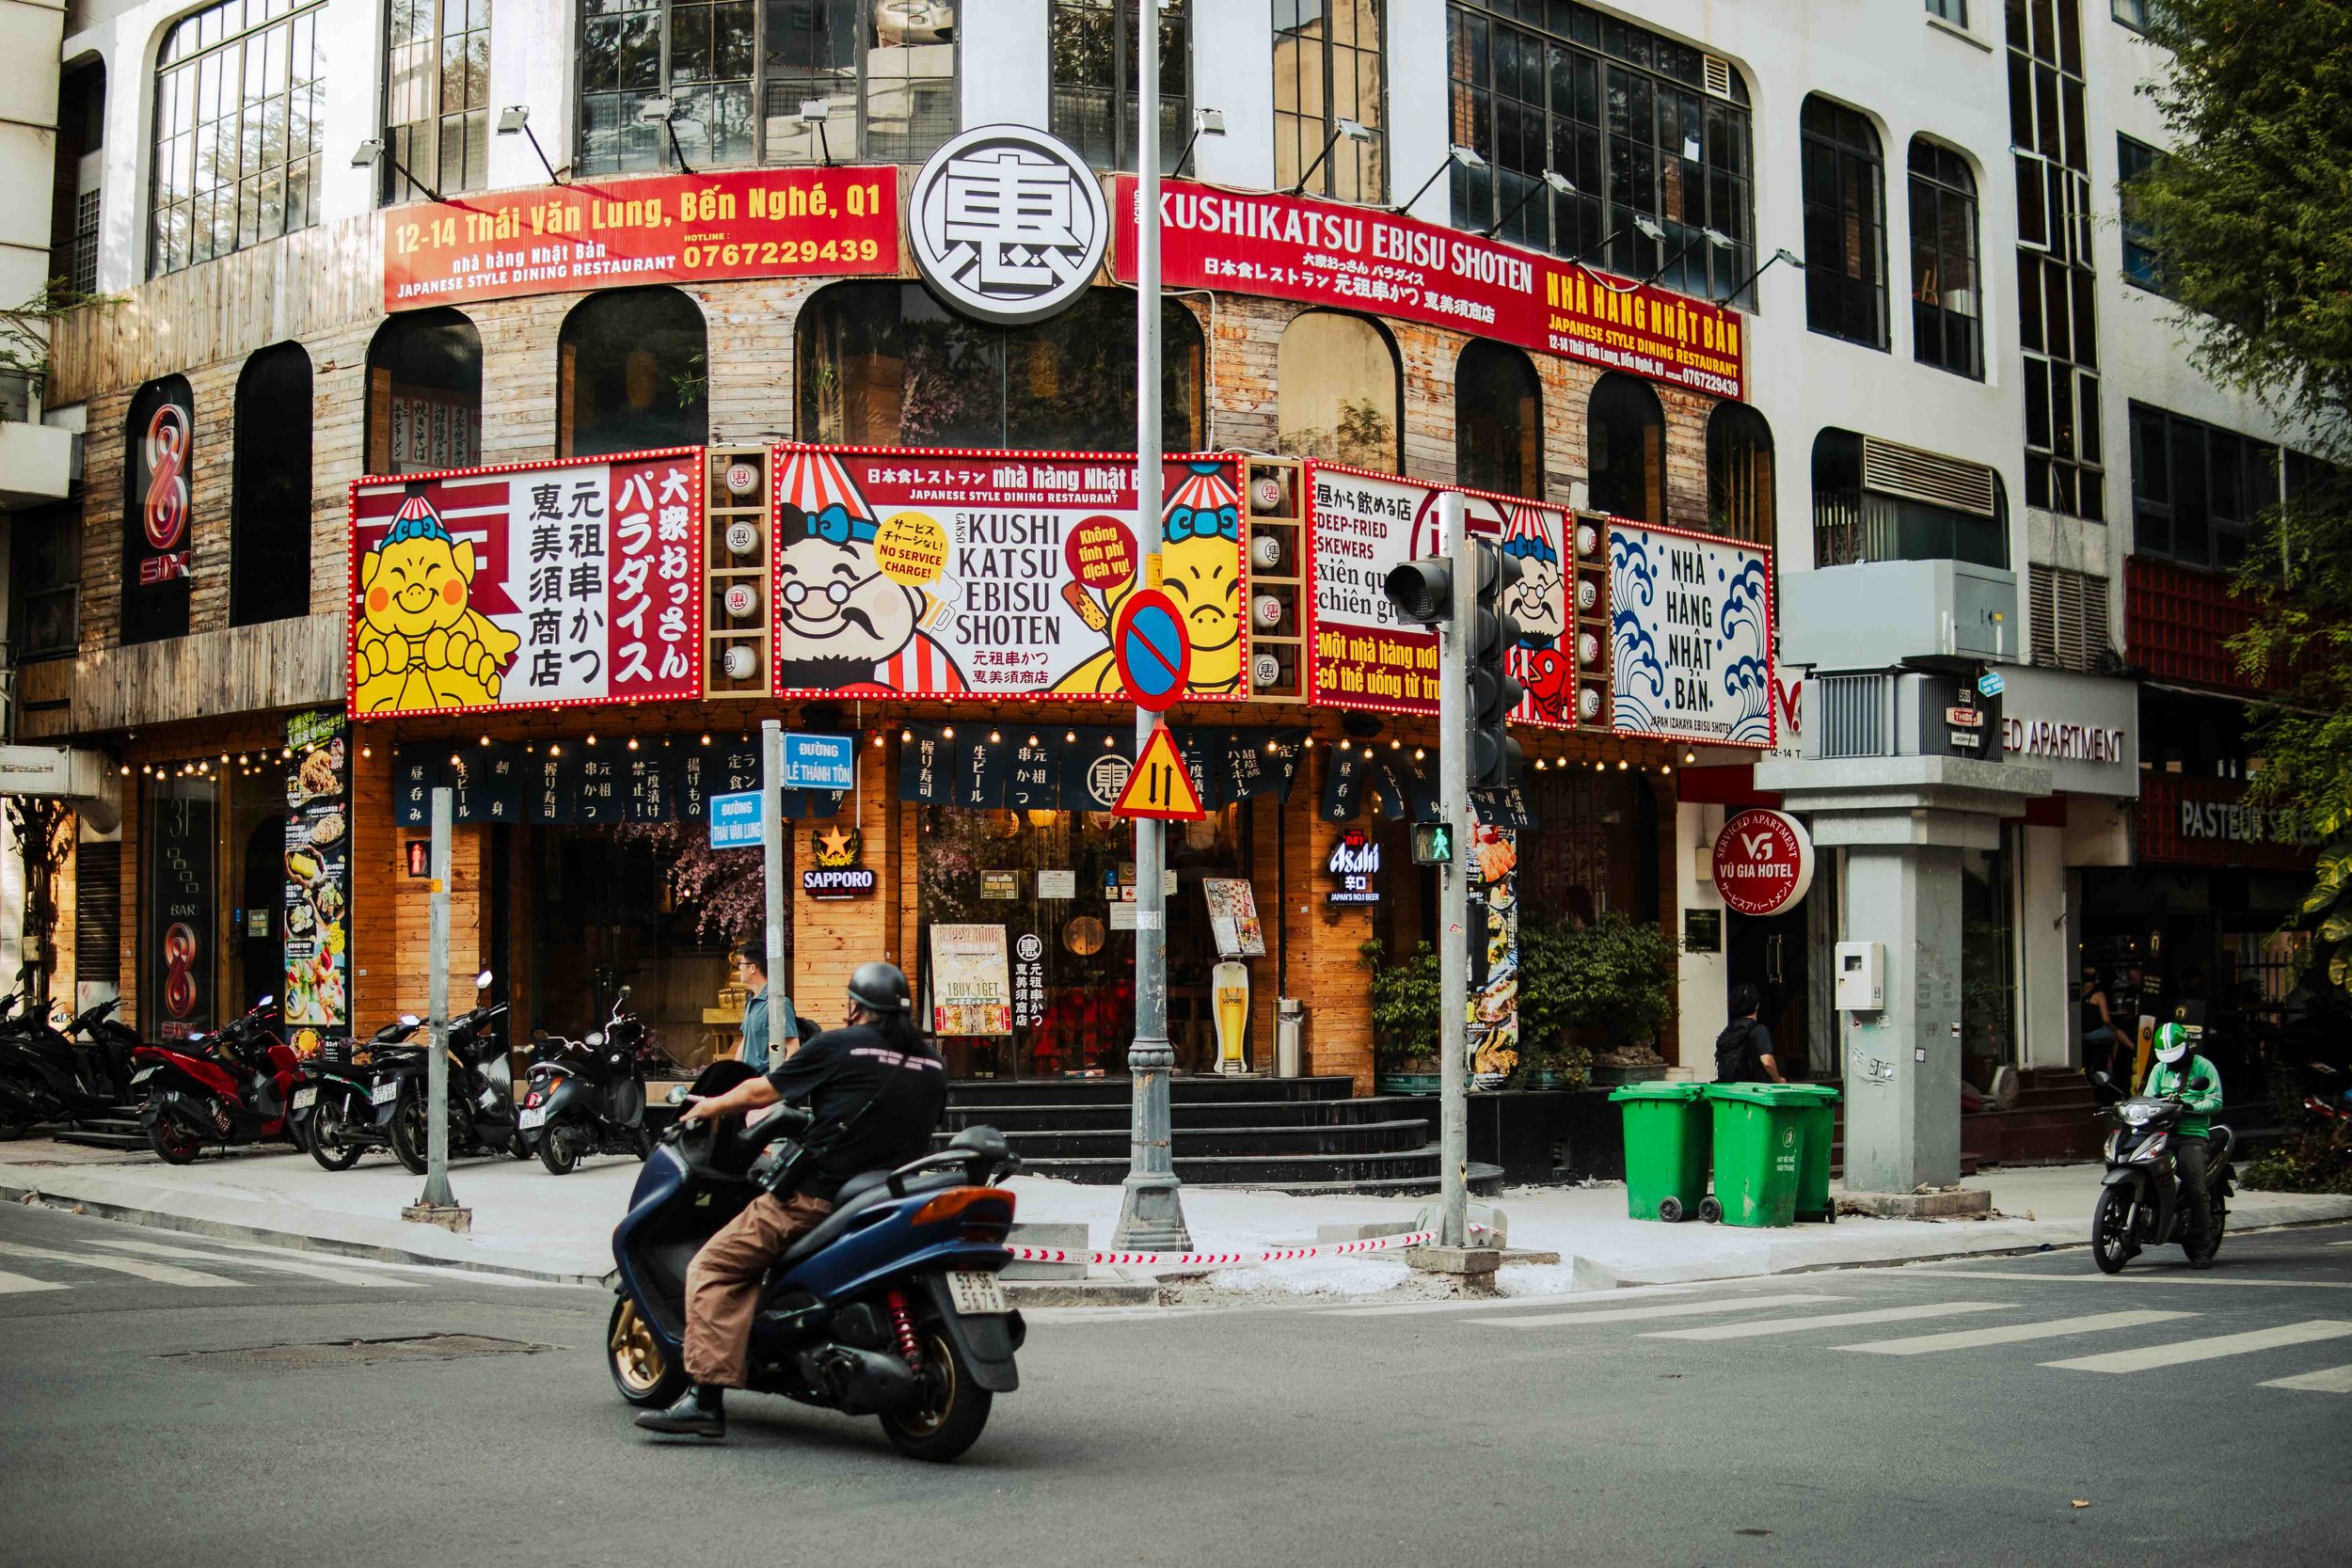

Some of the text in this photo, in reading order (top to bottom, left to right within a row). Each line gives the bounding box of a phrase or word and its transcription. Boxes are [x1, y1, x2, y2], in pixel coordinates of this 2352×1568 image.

[395, 182, 880, 254] 12-14 Thái Văn Lung, Bến Nghé, Q1
[453, 239, 606, 275] nhà hàng Nhật Bản
[683, 239, 879, 269] 0767229439
[1159, 192, 1363, 253] KUSHIKATSU
[1372, 222, 1445, 271] EBISU
[1451, 242, 1534, 294] SHOTEN
[397, 254, 676, 299] JAPANESE STYLE DINING RESTAURANT
[1204, 257, 1328, 289] 日本食レストラン
[1333, 273, 1420, 306] 元祖串かつ
[1372, 264, 1424, 287] パラダイス
[1546, 271, 1738, 357] NHÀ HÀNG NHẬT BẢN
[1548, 313, 1738, 378] JAPANESE STYLE DINING RESTAURANT
[1548, 334, 1568, 352] 12-14
[1568, 337, 1585, 356] Thái
[1655, 361, 1664, 377] Q1
[1682, 367, 1739, 397] 0767229439
[867, 468, 986, 486] 日本食レストラン
[993, 467, 1028, 489] nhà
[1032, 466, 1079, 492] hàng
[1084, 467, 1126, 495] Nhật
[909, 489, 1118, 503] JAPANESE STYLE DINING RESTAURANT
[1317, 483, 1411, 522] 昼から飲める店
[893, 518, 935, 536] サービス
[955, 513, 966, 544] GANSO
[968, 514, 1060, 545] KUSHI
[1079, 526, 1118, 545] Không
[1317, 513, 1388, 539] DEEP-FRIED
[880, 544, 943, 566] NO SERVICE
[959, 547, 1057, 578] KATSU
[1078, 540, 1125, 562] tính phí
[1317, 535, 1374, 561] SKEWERS
[612, 470, 656, 683] パラダイス
[658, 467, 690, 680] 大衆おっさん
[884, 561, 931, 578] CHARGE!
[1082, 562, 1110, 581] dịch
[1317, 558, 1388, 594] xiên qu
[1671, 543, 1706, 586] NHÀ
[567, 481, 606, 684] 元祖串かつ
[966, 581, 1050, 612] EBISU
[1318, 586, 1373, 615] chiên
[1665, 582, 1712, 629] HÀNG
[955, 614, 1060, 645] SHOTEN
[972, 650, 1049, 667] 元祖串かつ
[1318, 631, 1438, 670] Một nhà hàng nơi
[1668, 628, 1712, 676] NHẬT
[1319, 661, 1421, 699] có thể uống từ
[1675, 669, 1708, 713] BẢN
[1650, 715, 1733, 735] JAPAN IZAKAYA EBISU SHOTEN
[798, 741, 839, 758] ĐƯỜNG
[2028, 721, 2124, 763] APARTMENT
[599, 762, 612, 797] 元祖
[787, 760, 851, 784] LÊ THÁNH TÔN
[919, 739, 935, 798] 握り寿司
[970, 744, 987, 803] 生ビール
[1015, 746, 1031, 804] 串かつ
[1031, 748, 1048, 784] 元祖
[544, 762, 557, 818] 握り寿司
[583, 762, 597, 818] 串かつ
[647, 761, 660, 817] 二度漬け
[687, 757, 701, 816] 揚げもの
[721, 800, 754, 816] ĐƯỜNG
[712, 821, 762, 842] THÁI VĂN LUNG
[1717, 815, 1798, 859] SERVICED APARTMENT
[1329, 842, 1379, 873] Asahi
[1720, 862, 1793, 878] VŨ GIA HOTEL
[803, 871, 873, 888] SAPPORO
[1344, 875, 1366, 891] 辛口
[170, 904, 197, 916] BAR
[1330, 893, 1353, 901] JAPAN'S
[1365, 893, 1380, 901] BEER
[936, 927, 1000, 942] HAPPY HOUR
[947, 982, 999, 997] 1BUY 1GET
[1028, 962, 1043, 1027] 元祖串かつ
[961, 1291, 999, 1310] 5678
